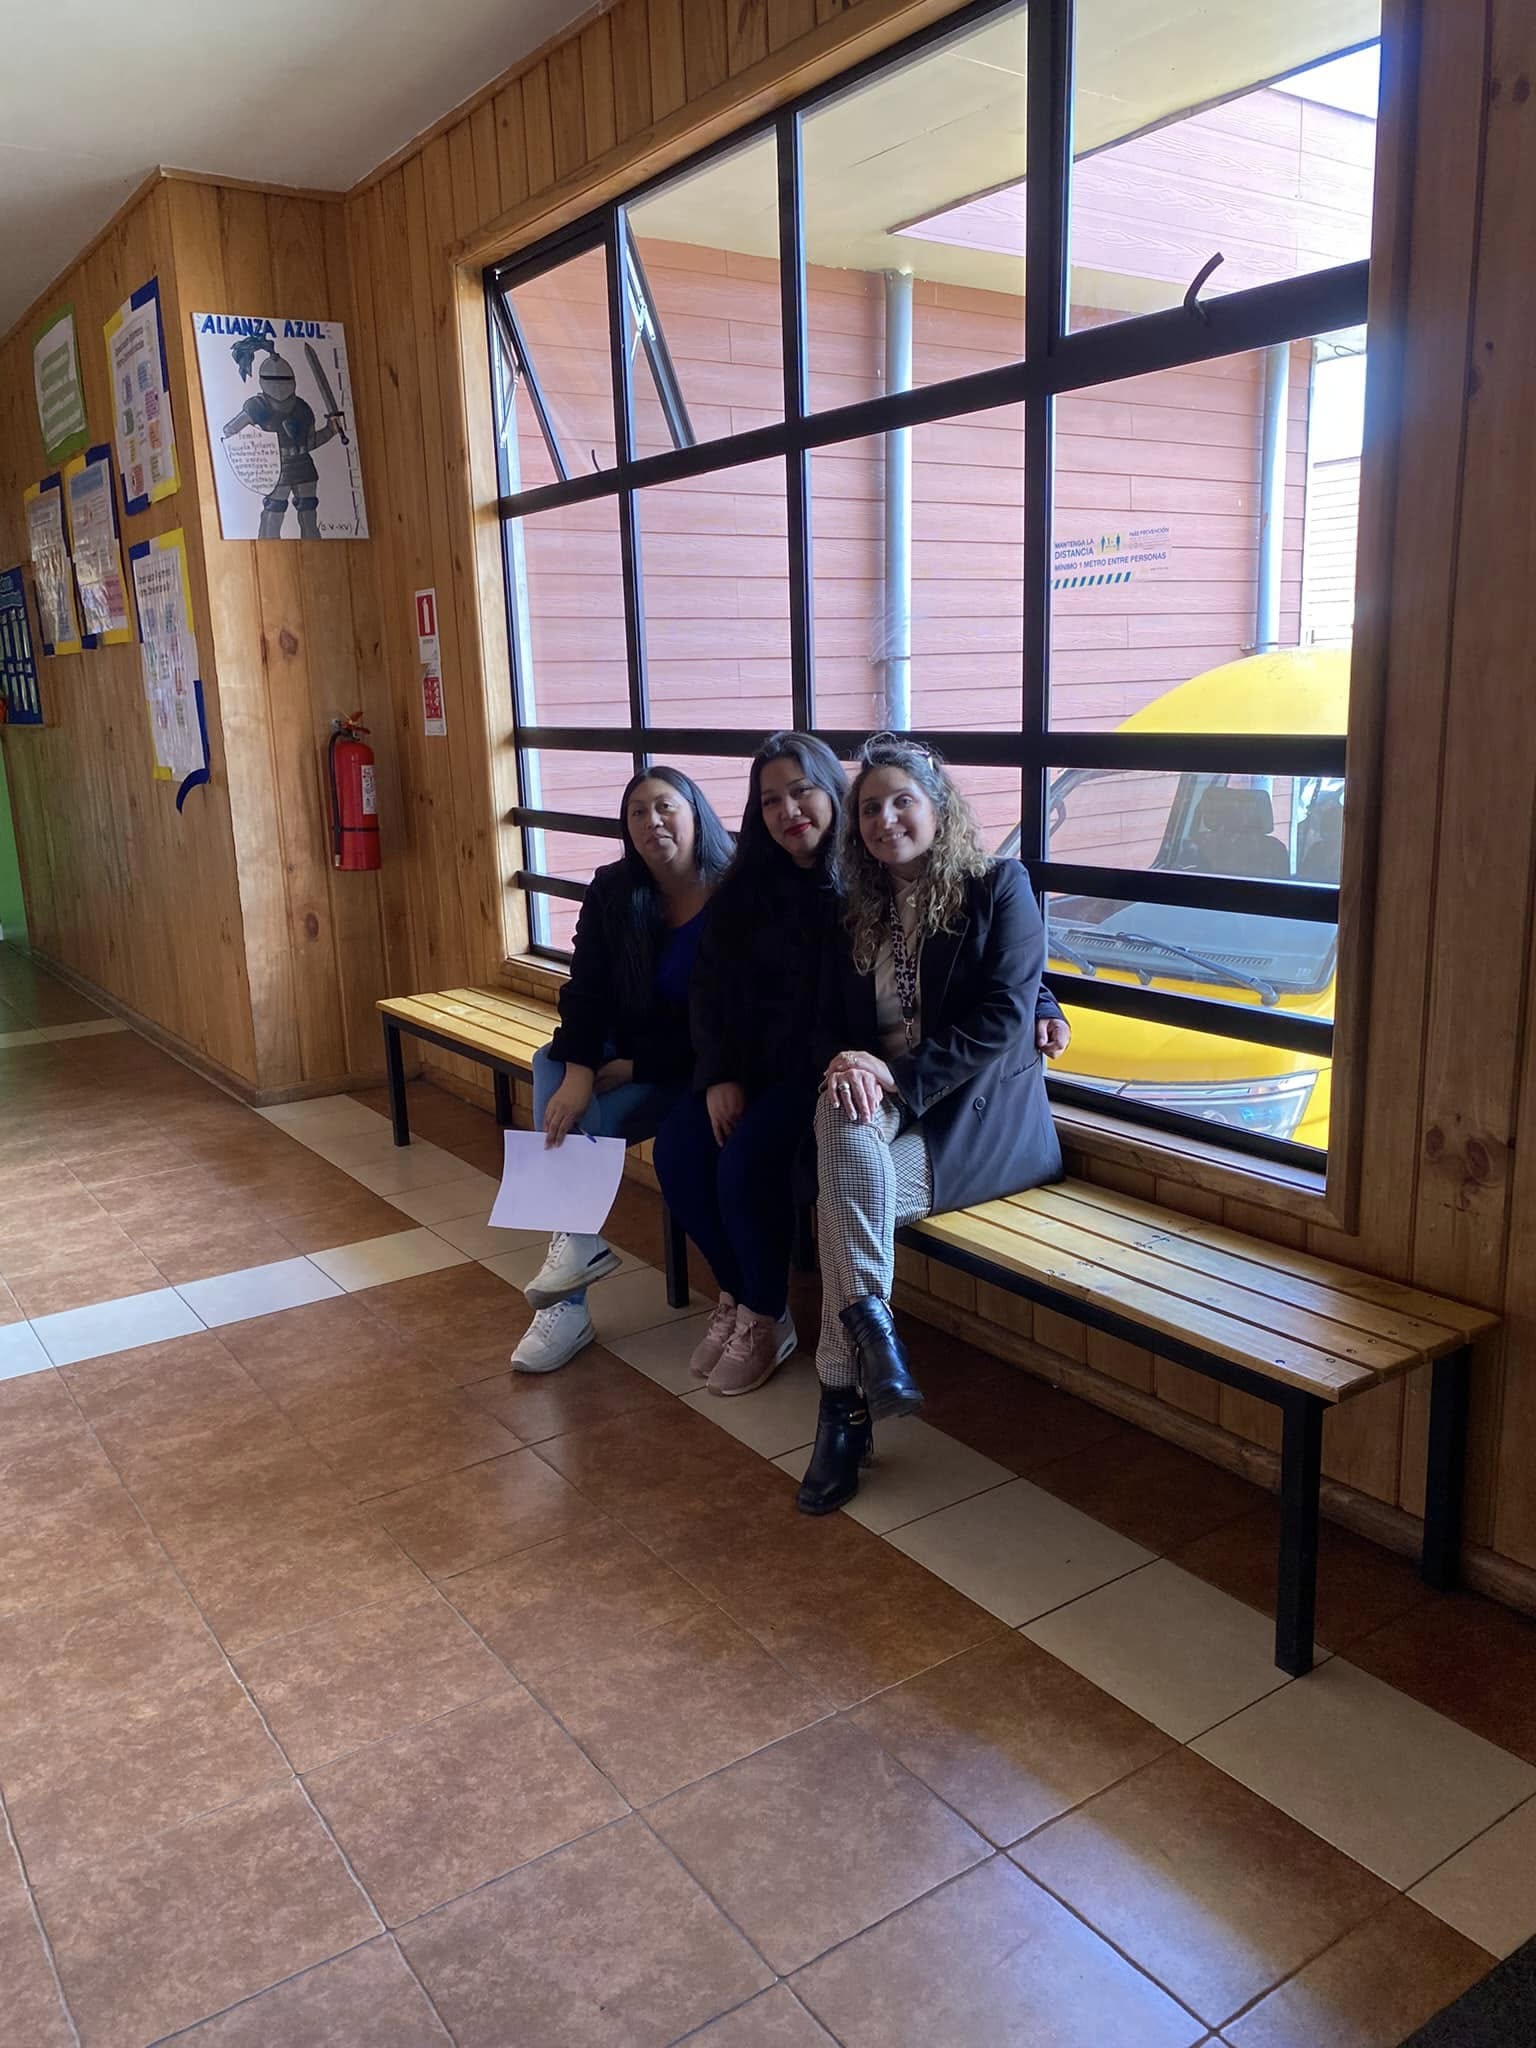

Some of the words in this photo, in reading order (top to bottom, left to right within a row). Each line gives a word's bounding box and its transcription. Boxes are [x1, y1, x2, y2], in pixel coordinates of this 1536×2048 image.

[201, 315, 277, 338] ALIANZA
[284, 320, 326, 339] AZUL
[1055, 540, 1085, 549] MANTENGA
[1086, 537, 1094, 546] LA
[1055, 547, 1094, 560] DISTANCIA
[1083, 558, 1106, 569] METRO
[1107, 555, 1129, 566] ENTRE
[1130, 552, 1167, 563] PERSONAS
